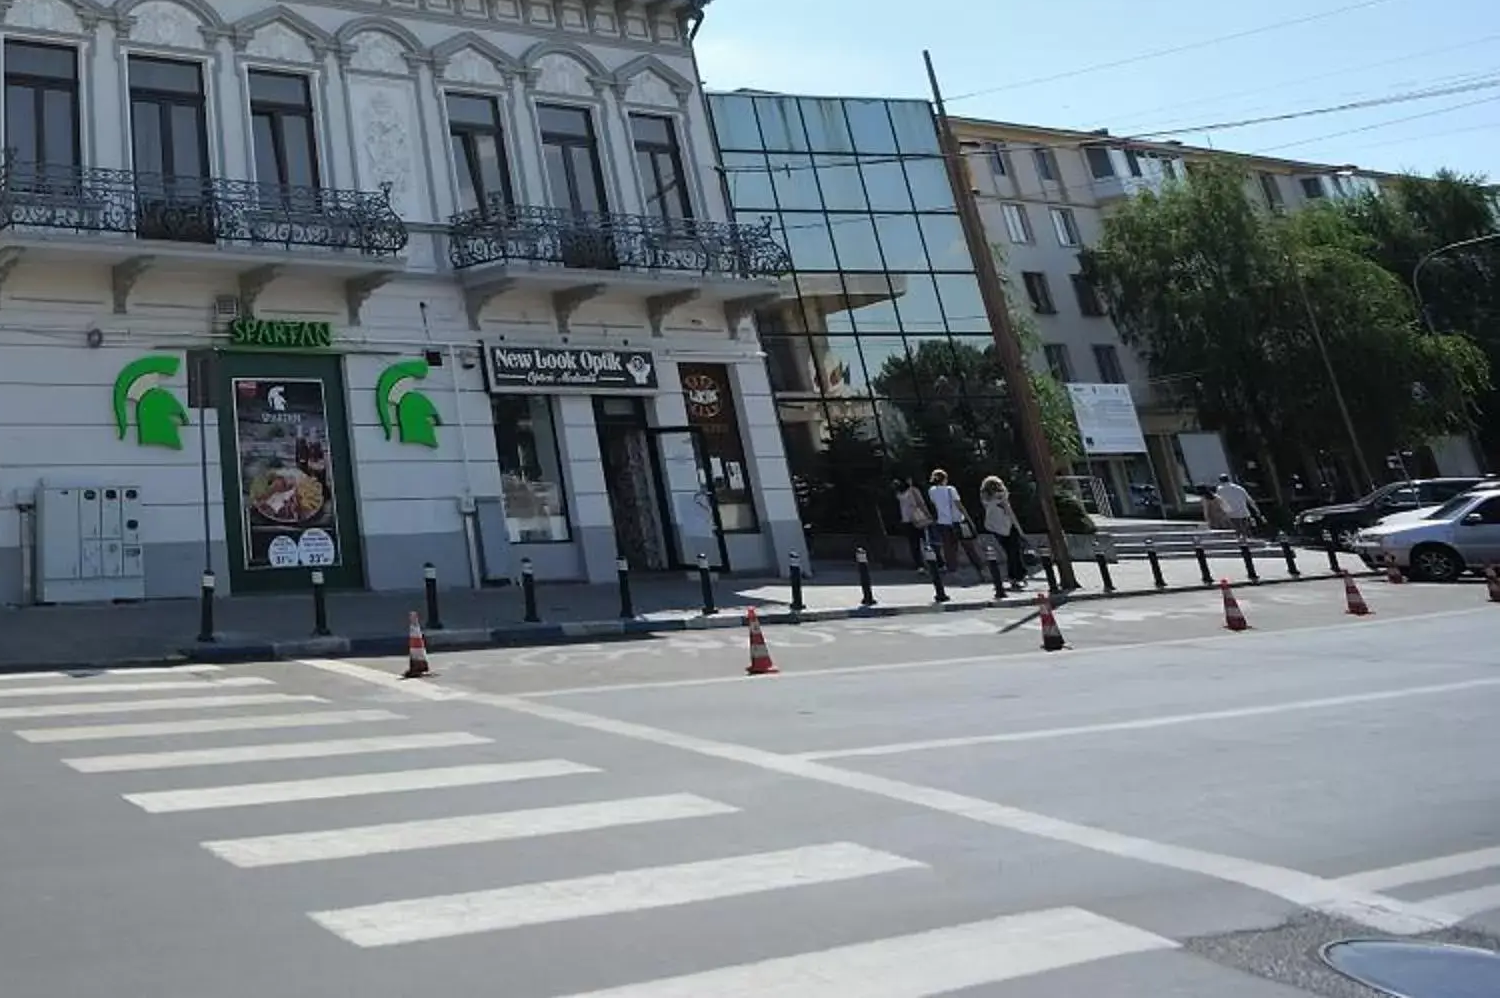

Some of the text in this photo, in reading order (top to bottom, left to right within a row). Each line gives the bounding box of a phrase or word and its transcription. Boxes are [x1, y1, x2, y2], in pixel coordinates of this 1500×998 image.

[232, 318, 331, 346] SPARTAN
[495, 349, 623, 375] New Look Optik
